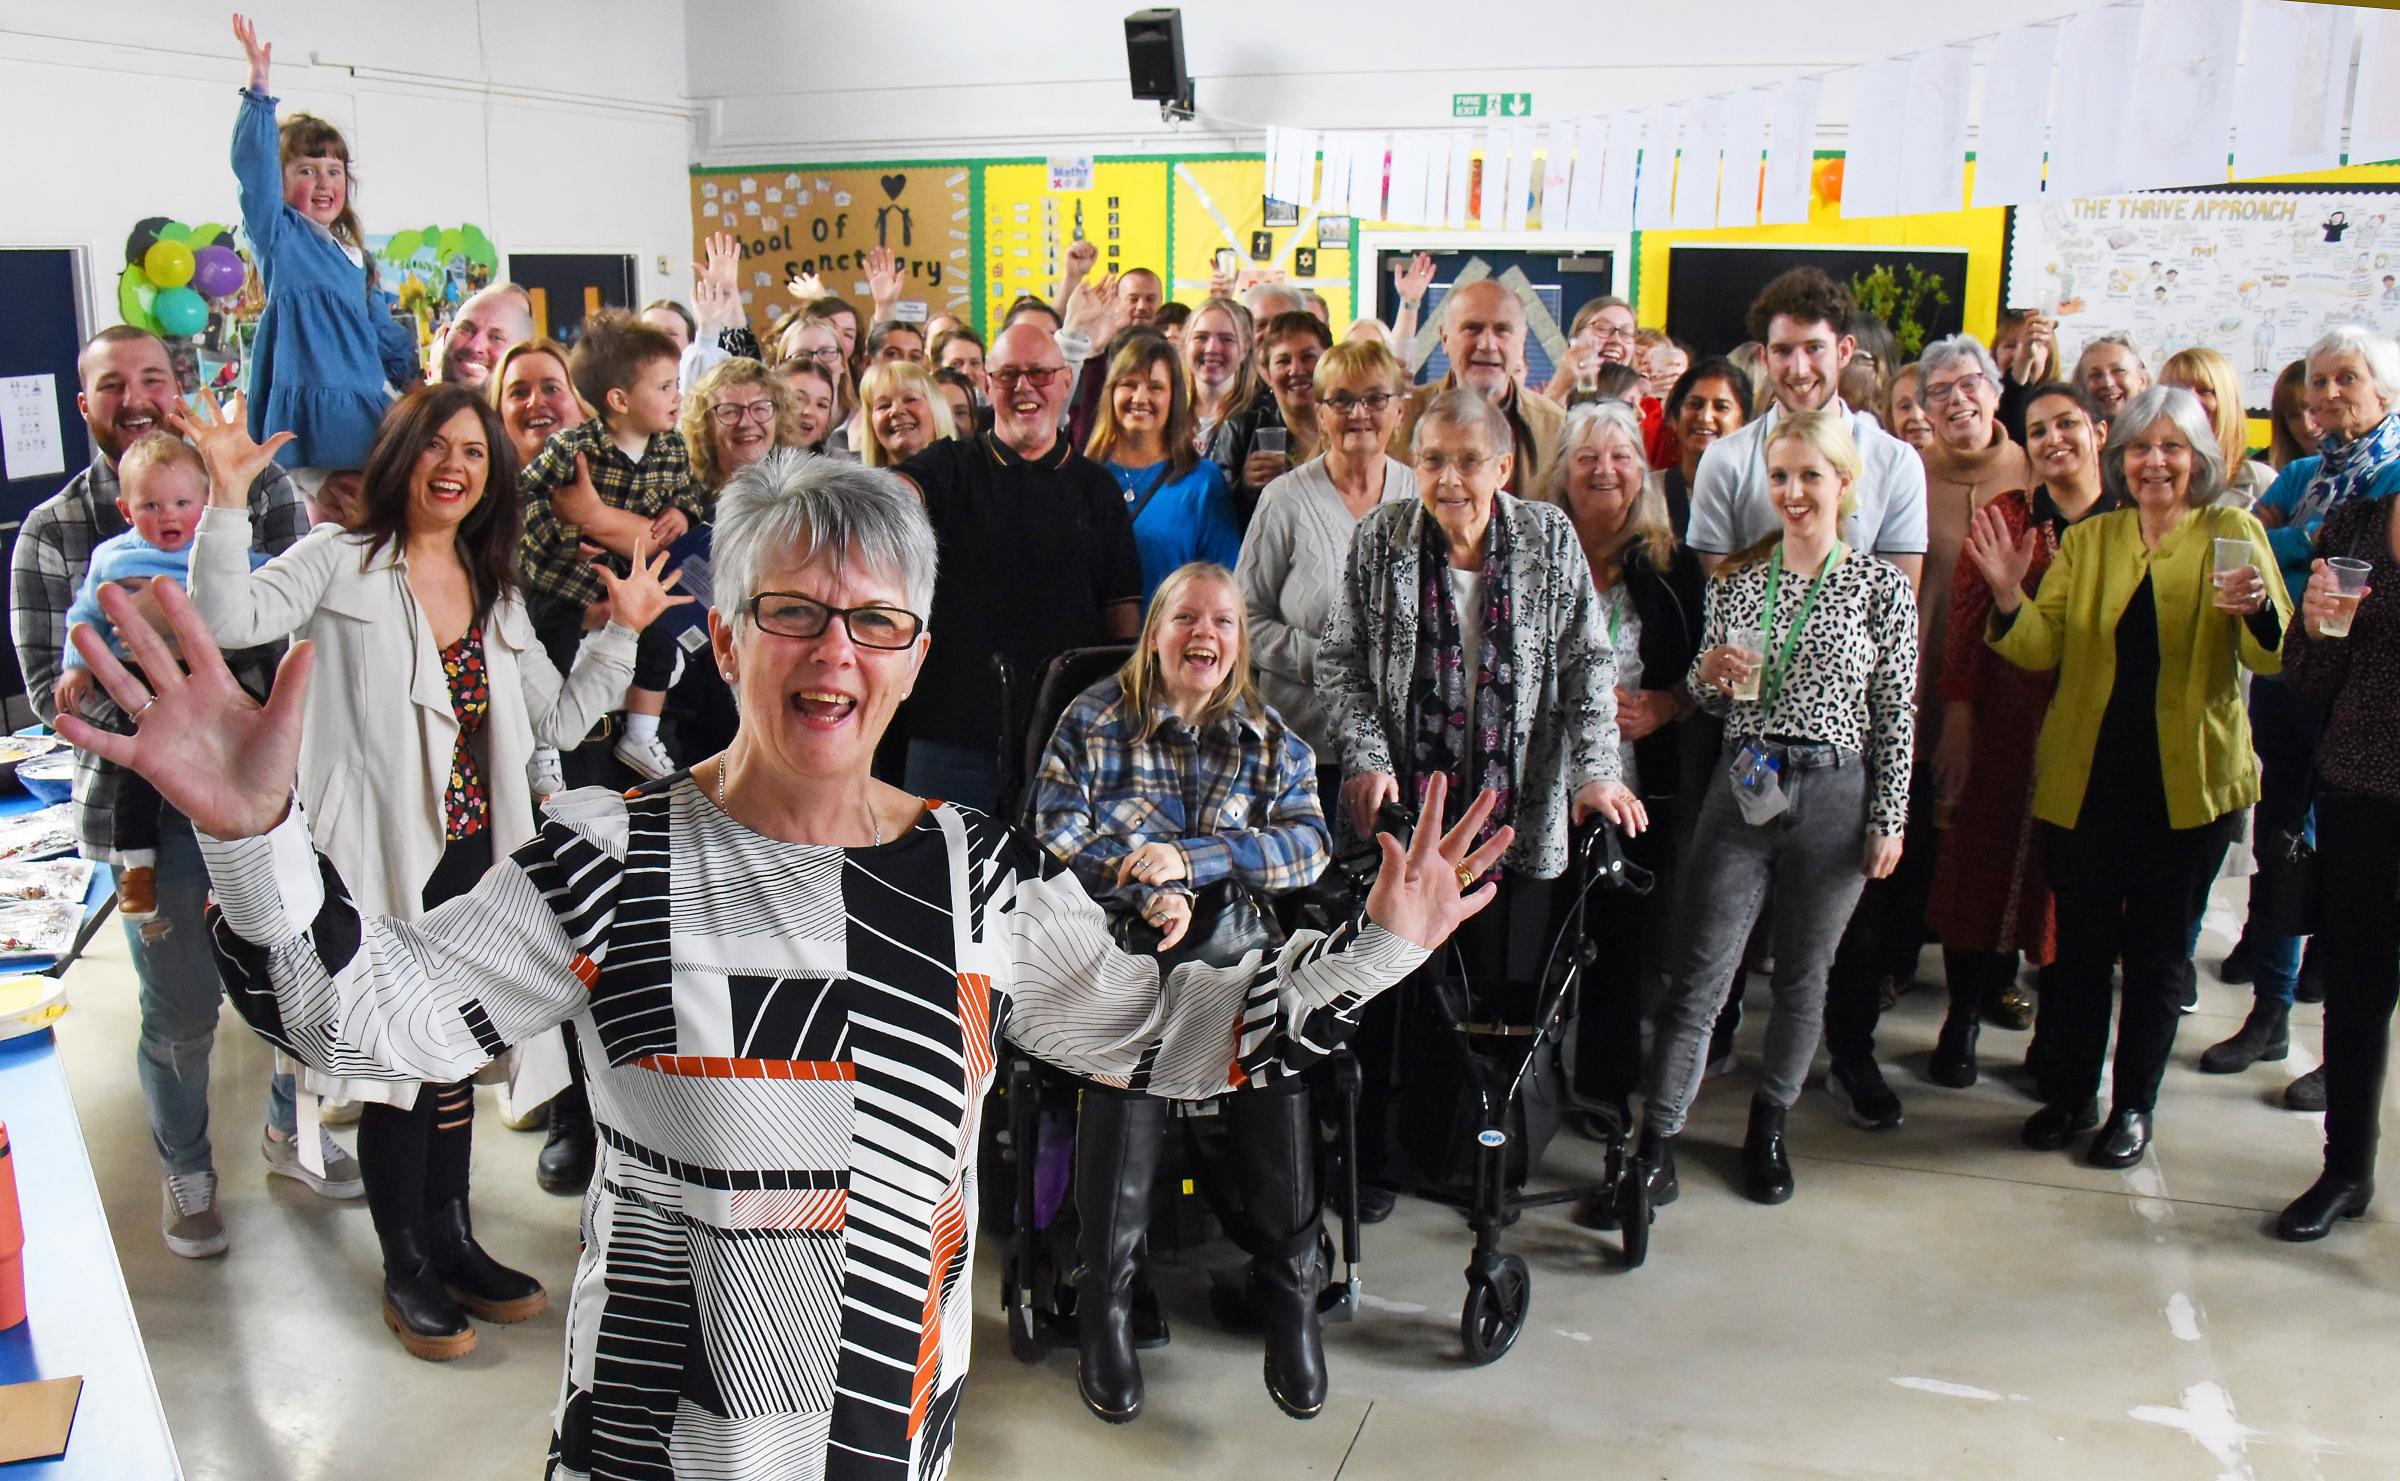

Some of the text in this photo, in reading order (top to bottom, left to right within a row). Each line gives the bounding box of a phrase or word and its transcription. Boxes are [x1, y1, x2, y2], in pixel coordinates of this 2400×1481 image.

[1456, 95, 1480, 105] FIRE
[1456, 106, 1480, 116] EXIT
[2071, 198, 2298, 222] THE THRIVE APPROACH
[811, 213, 848, 243] Of
[784, 249, 942, 287] sanctary
